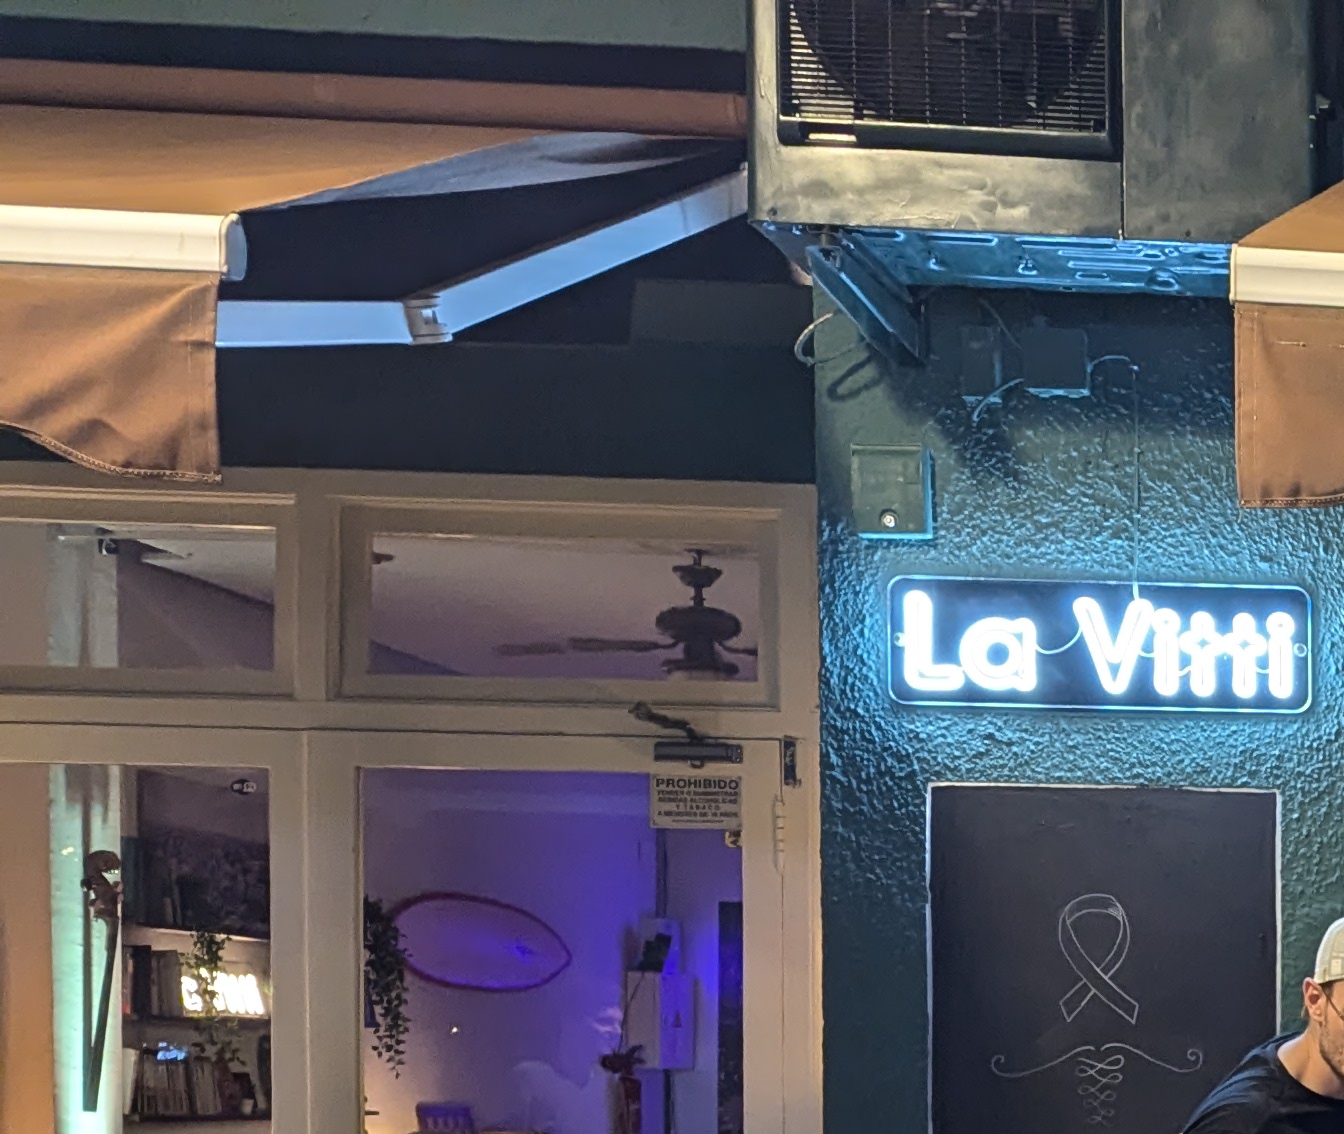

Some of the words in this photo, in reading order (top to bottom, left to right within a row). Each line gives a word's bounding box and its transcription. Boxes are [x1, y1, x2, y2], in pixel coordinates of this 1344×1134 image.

[903, 590, 1037, 692] La
[1072, 596, 1295, 699] Vitti
[655, 778, 739, 790] PROHIBIDO
